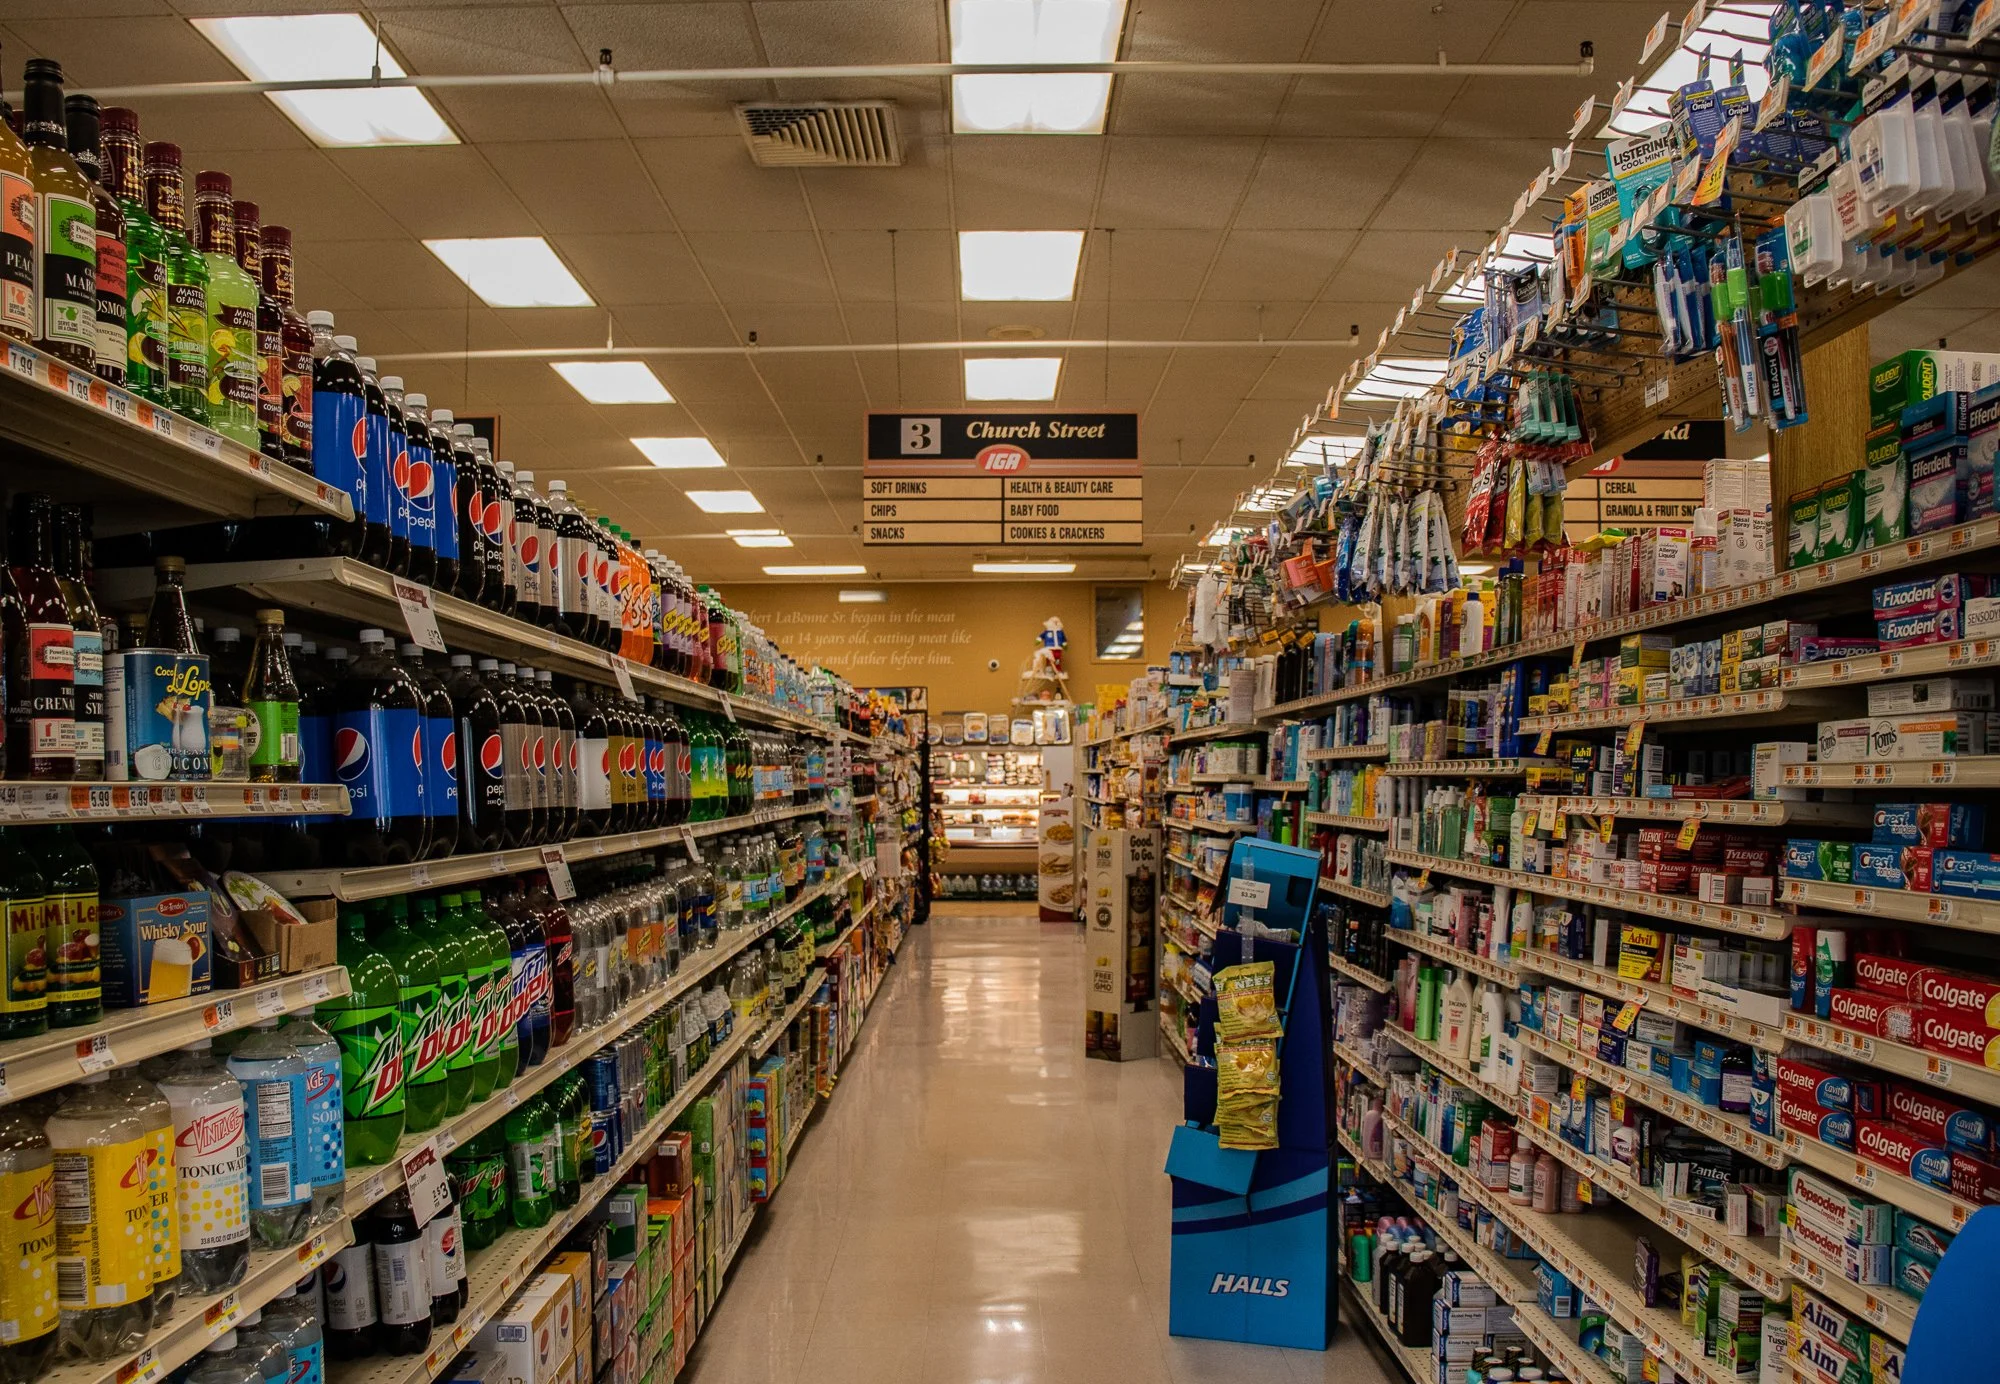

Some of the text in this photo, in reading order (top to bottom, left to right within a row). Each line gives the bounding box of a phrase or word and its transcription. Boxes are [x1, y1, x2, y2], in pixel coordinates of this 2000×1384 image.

[1691, 100, 1714, 111] Orajel
[1727, 105, 1750, 116] Orajel
[1621, 149, 1666, 172] COOL MINT
[176, 295, 186, 304] OF
[233, 318, 242, 326] OF
[11, 351, 33, 376] 7.99
[1772, 358, 1780, 397] REACH
[1875, 364, 1900, 385] POLIDENT
[68, 378, 89, 402] 7.99
[1747, 371, 1756, 398] REACH
[1783, 375, 1792, 402] REACH
[1731, 383, 1740, 409] REACH
[107, 395, 126, 418] 7.99
[1957, 394, 1968, 431] Efferdent
[154, 411, 171, 436] 7.99
[966, 421, 1106, 439] Church Street
[1662, 423, 1690, 440] Rd
[1912, 419, 1934, 435] Efferdent
[910, 423, 931, 450] 3
[1867, 440, 1900, 462] POLIDENT
[984, 453, 1022, 470] IGA
[1912, 452, 1953, 479] Efferdent
[871, 482, 927, 495] SOFT DRINKS
[1010, 481, 1114, 494] HEALTH & BEAUTY CARE
[1605, 482, 1637, 494] CEREAL
[1824, 491, 1849, 508] POLIDENT
[871, 505, 897, 517] CHIPS
[1010, 504, 1059, 516] BABY FOOD
[1605, 505, 1679, 517] GRANOLA & FRUIT
[1794, 502, 1818, 518] POLIDENT
[1010, 527, 1105, 540] COOKIES & CRACKERS
[1733, 521, 1750, 529] Spray
[1889, 525, 1900, 538] 84
[870, 528, 905, 540] SNACKS
[1658, 547, 1679, 556] Allergy
[1842, 538, 1852, 550] 40
[1881, 585, 1936, 608] Fixodent
[775, 608, 955, 629] LaBonne Sr. began in the meat
[1886, 617, 1935, 640] Fixodent
[781, 632, 794, 644] at
[798, 631, 812, 644] 14
[814, 634, 845, 650] years
[849, 630, 871, 646] old,
[873, 632, 915, 649] cutting
[918, 632, 948, 644] meat
[951, 629, 973, 644] like
[825, 652, 849, 666] and
[846, 651, 887, 671] father
[890, 651, 925, 671] before
[927, 651, 955, 666] him.
[1818, 731, 1837, 753] Tom's
[1871, 726, 1897, 751] Tom's
[1574, 747, 1592, 757] Advil
[91, 788, 110, 808] 5.99
[130, 788, 148, 808] 5.99
[1873, 811, 1909, 828] Crest
[1129, 834, 1154, 848] Good.
[1638, 829, 1662, 843] TYLENOL
[1096, 849, 1111, 860] NO
[1129, 848, 1155, 861] To Go.
[1725, 850, 1764, 860] TYLENOL
[1787, 847, 1815, 862] Crest
[1859, 852, 1893, 869] Crest
[1640, 860, 1658, 875] TYLENOL
[1660, 863, 1687, 872] TYLENOL
[1691, 865, 1718, 873] TYLENOL
[1943, 857, 1977, 873] Crest
[1099, 912, 1109, 922] GF
[140, 919, 207, 942] Whisky Sour
[1627, 933, 1653, 946] Advil
[1095, 972, 1112, 981] FREE
[1856, 958, 1908, 988] Colgate
[1094, 982, 1112, 992] GMO
[1923, 979, 1986, 1010] Colgate
[217, 1002, 232, 1022] 3.49
[1831, 994, 1878, 1023] Colgate
[1924, 1018, 1985, 1051] Colgate
[1655, 1052, 1670, 1065] ALEVE
[1702, 1047, 1715, 1059] ALEVE
[1777, 1066, 1815, 1090] Colgate
[1824, 1082, 1844, 1095] Cavity
[312, 1108, 341, 1124] SODA
[1781, 1099, 1817, 1125] Colgate
[1893, 1092, 1945, 1126] Colgate
[192, 1107, 242, 1155] VINTAGE
[1826, 1117, 1846, 1131] Cavity
[1955, 1115, 1979, 1130] Cavity
[1859, 1126, 1911, 1162] Colgate
[1920, 1153, 1944, 1170] Cavity
[1953, 1157, 1978, 1174] Colgate
[179, 1162, 225, 1179] TONIC
[1690, 1162, 1731, 1181] Zantac
[1952, 1170, 1981, 1187] OPTIC
[1952, 1179, 1981, 1200] WHITE
[1795, 1178, 1846, 1219] Pepsodent
[1794, 1216, 1842, 1258] Pepsodent
[1905, 1229, 1939, 1254] Aquafresh
[1210, 1273, 1290, 1298] HALLS
[1800, 1300, 1839, 1339] Aim
[1798, 1338, 1838, 1377] Aim
